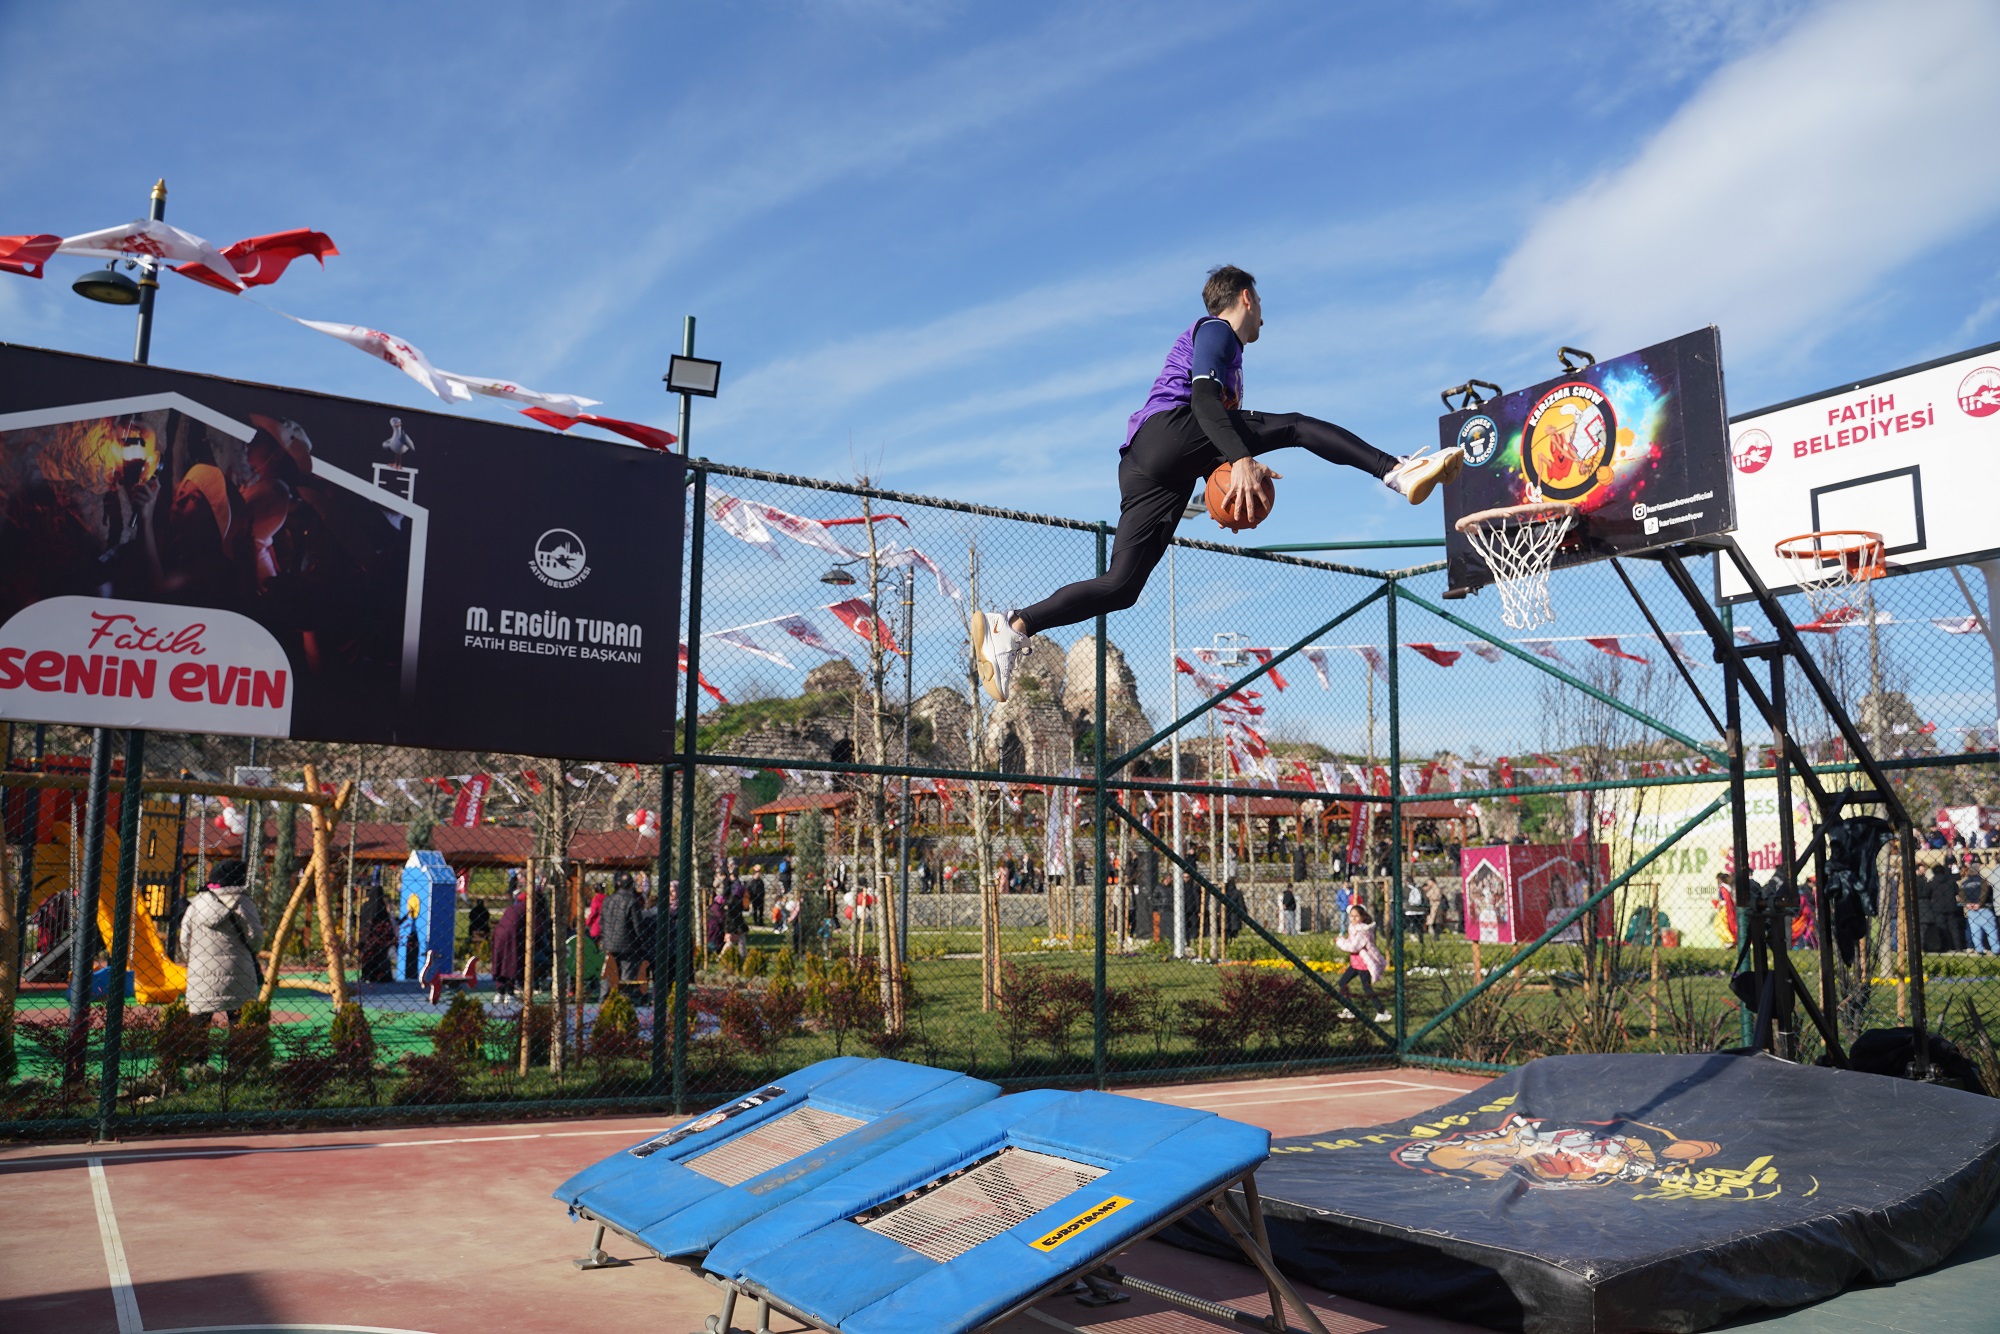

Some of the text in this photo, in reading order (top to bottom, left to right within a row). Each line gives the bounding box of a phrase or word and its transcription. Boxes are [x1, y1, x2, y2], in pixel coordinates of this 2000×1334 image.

[1572, 386, 1604, 405] SHOW
[1828, 393, 1895, 426] FATİH
[1461, 418, 1491, 438] GUINNESS
[1793, 402, 1934, 459] BELEDİYESİ
[1476, 431, 1496, 464] RECORDS
[1647, 490, 1713, 513] karizmashowofficial
[1659, 512, 1704, 527] karizmashow
[88, 610, 207, 655] Fatih
[500, 609, 571, 641] ERGÜN
[575, 618, 643, 648] TURAN
[580, 647, 642, 664] BAŞKANI
[1042, 1200, 1118, 1247] EUROTRAMP
